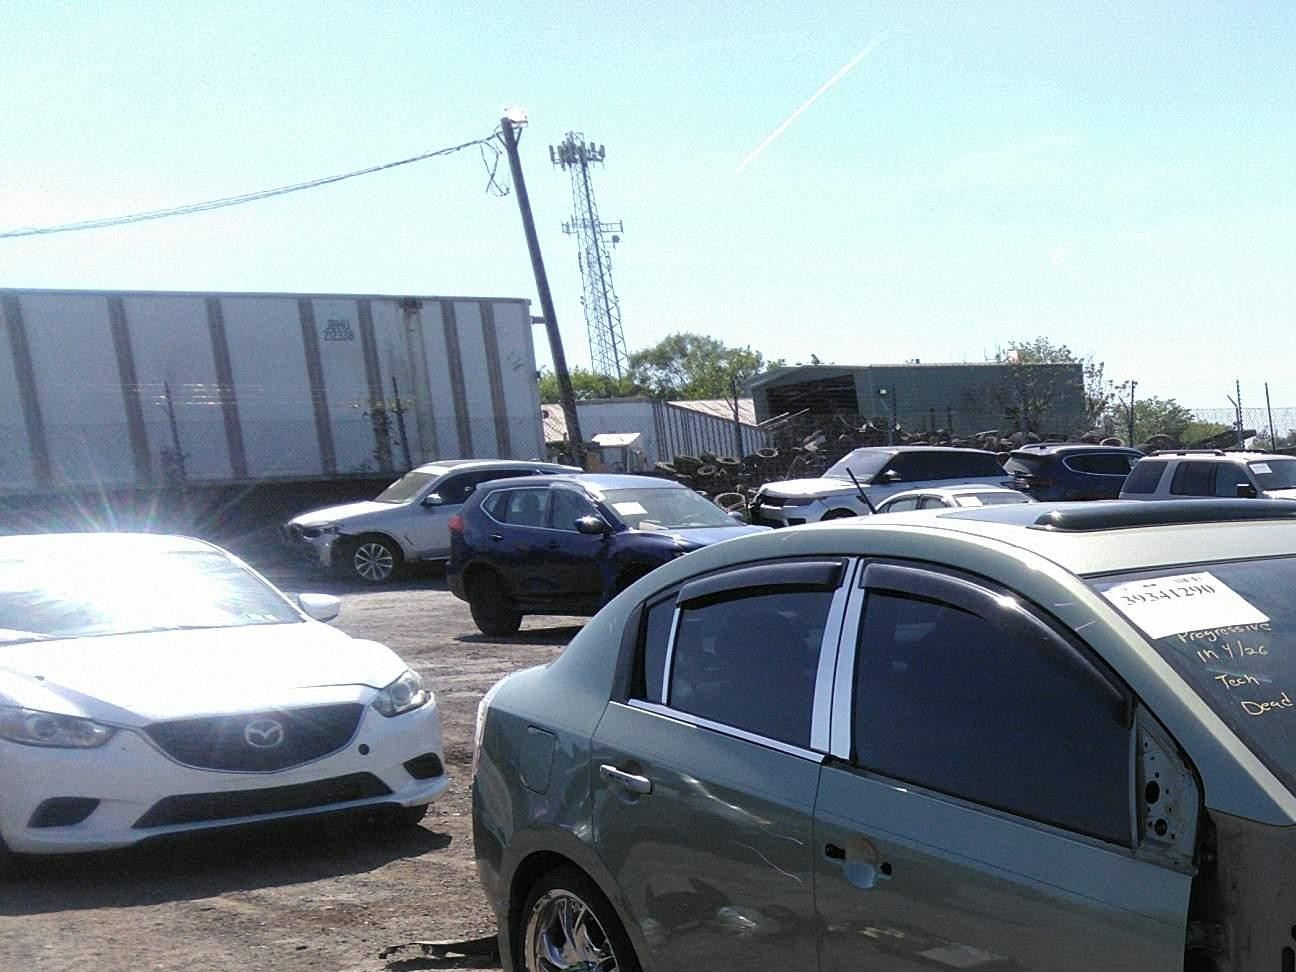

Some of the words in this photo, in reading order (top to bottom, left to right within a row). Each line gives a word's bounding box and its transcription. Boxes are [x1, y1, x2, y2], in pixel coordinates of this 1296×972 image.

[1120, 584, 1216, 606] 39341290
[1214, 674, 1260, 690] Tech
[1241, 692, 1294, 716] Dead
